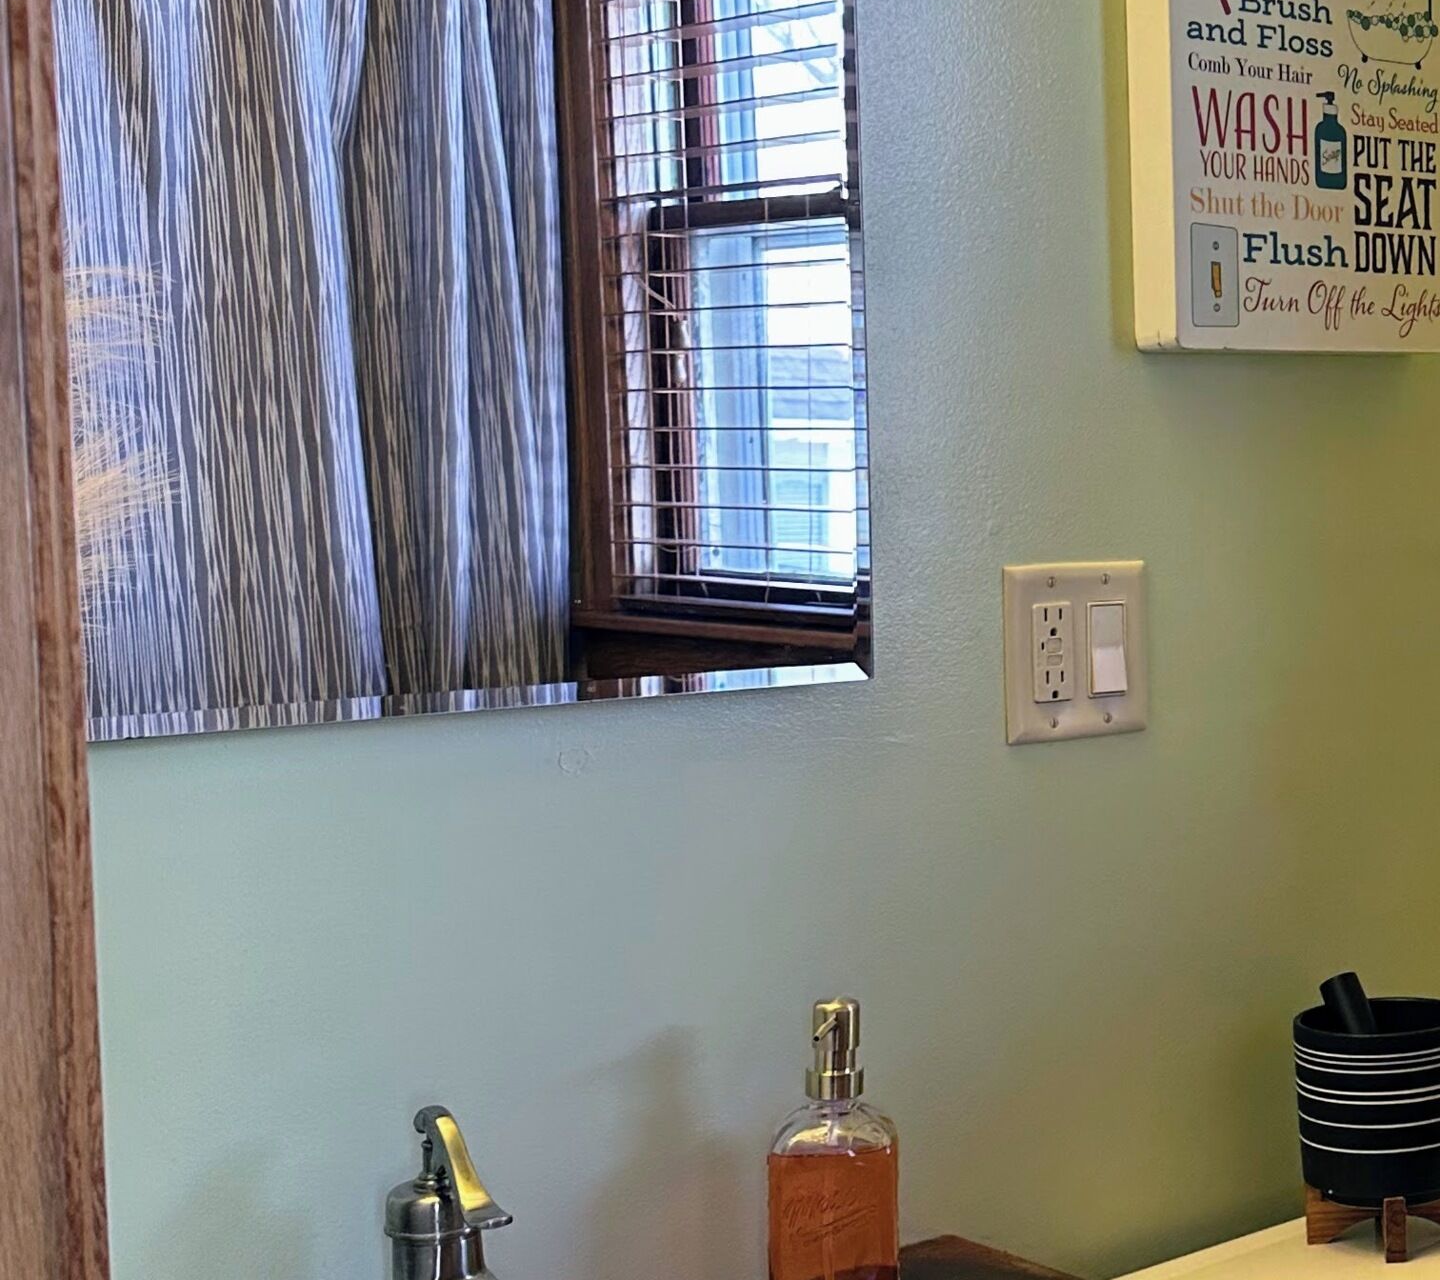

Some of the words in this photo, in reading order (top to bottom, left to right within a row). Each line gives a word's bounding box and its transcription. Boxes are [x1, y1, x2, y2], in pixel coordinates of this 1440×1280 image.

[1187, 19, 1247, 46] and
[1256, 24, 1333, 57] Floss
[1188, 51, 1230, 75] Comb
[1235, 57, 1273, 83] Your
[1277, 63, 1313, 85] Hair
[1337, 63, 1363, 94] No
[1367, 68, 1439, 114] Splashing
[1192, 85, 1308, 156] WASH
[1351, 102, 1385, 133] Stay
[1388, 106, 1439, 134] Seated
[1200, 149, 1247, 181] YOUR
[1253, 154, 1310, 186] HANDS
[1353, 134, 1391, 169] PUT
[1397, 138, 1437, 174] THE
[1190, 185, 1246, 217] Shut
[1250, 191, 1285, 221] the
[1292, 193, 1344, 223] Door
[1353, 172, 1437, 231] SEAT
[1242, 230, 1349, 268] Flush
[1353, 230, 1437, 276] DOWN
[1243, 276, 1301, 313] Turn
[1307, 279, 1346, 332] Off
[1350, 285, 1375, 320] the
